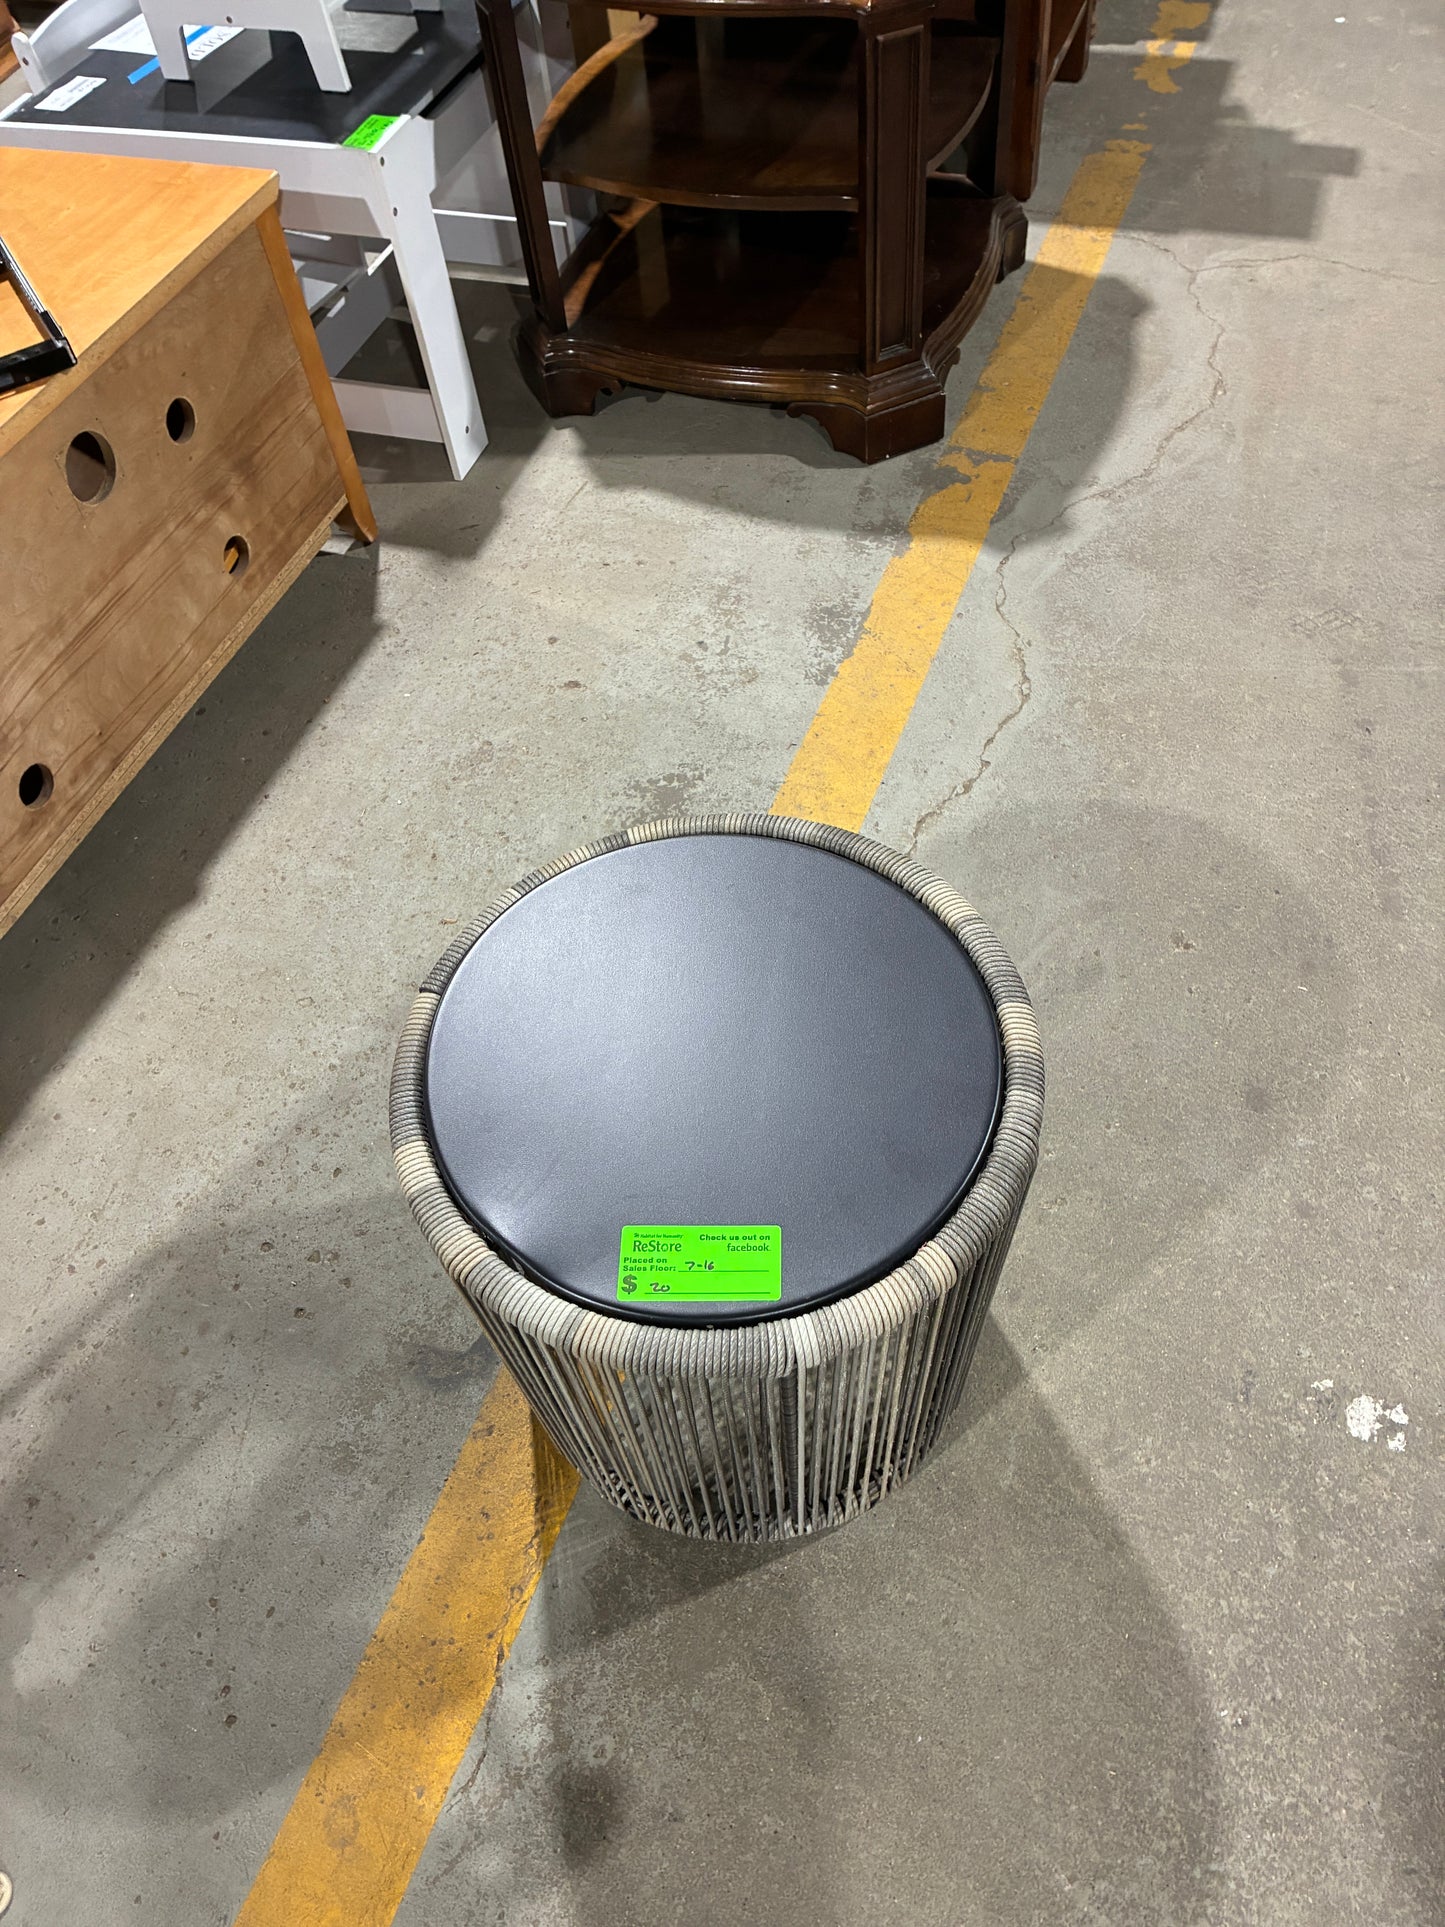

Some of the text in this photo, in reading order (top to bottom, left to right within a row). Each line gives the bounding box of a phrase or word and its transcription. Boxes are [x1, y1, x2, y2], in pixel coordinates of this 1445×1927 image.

[633, 1240, 682, 1252] ReStore
[727, 1243, 770, 1252] facebook
[684, 1259, 715, 1271] 7-16
[621, 1274, 671, 1295] $ 20
